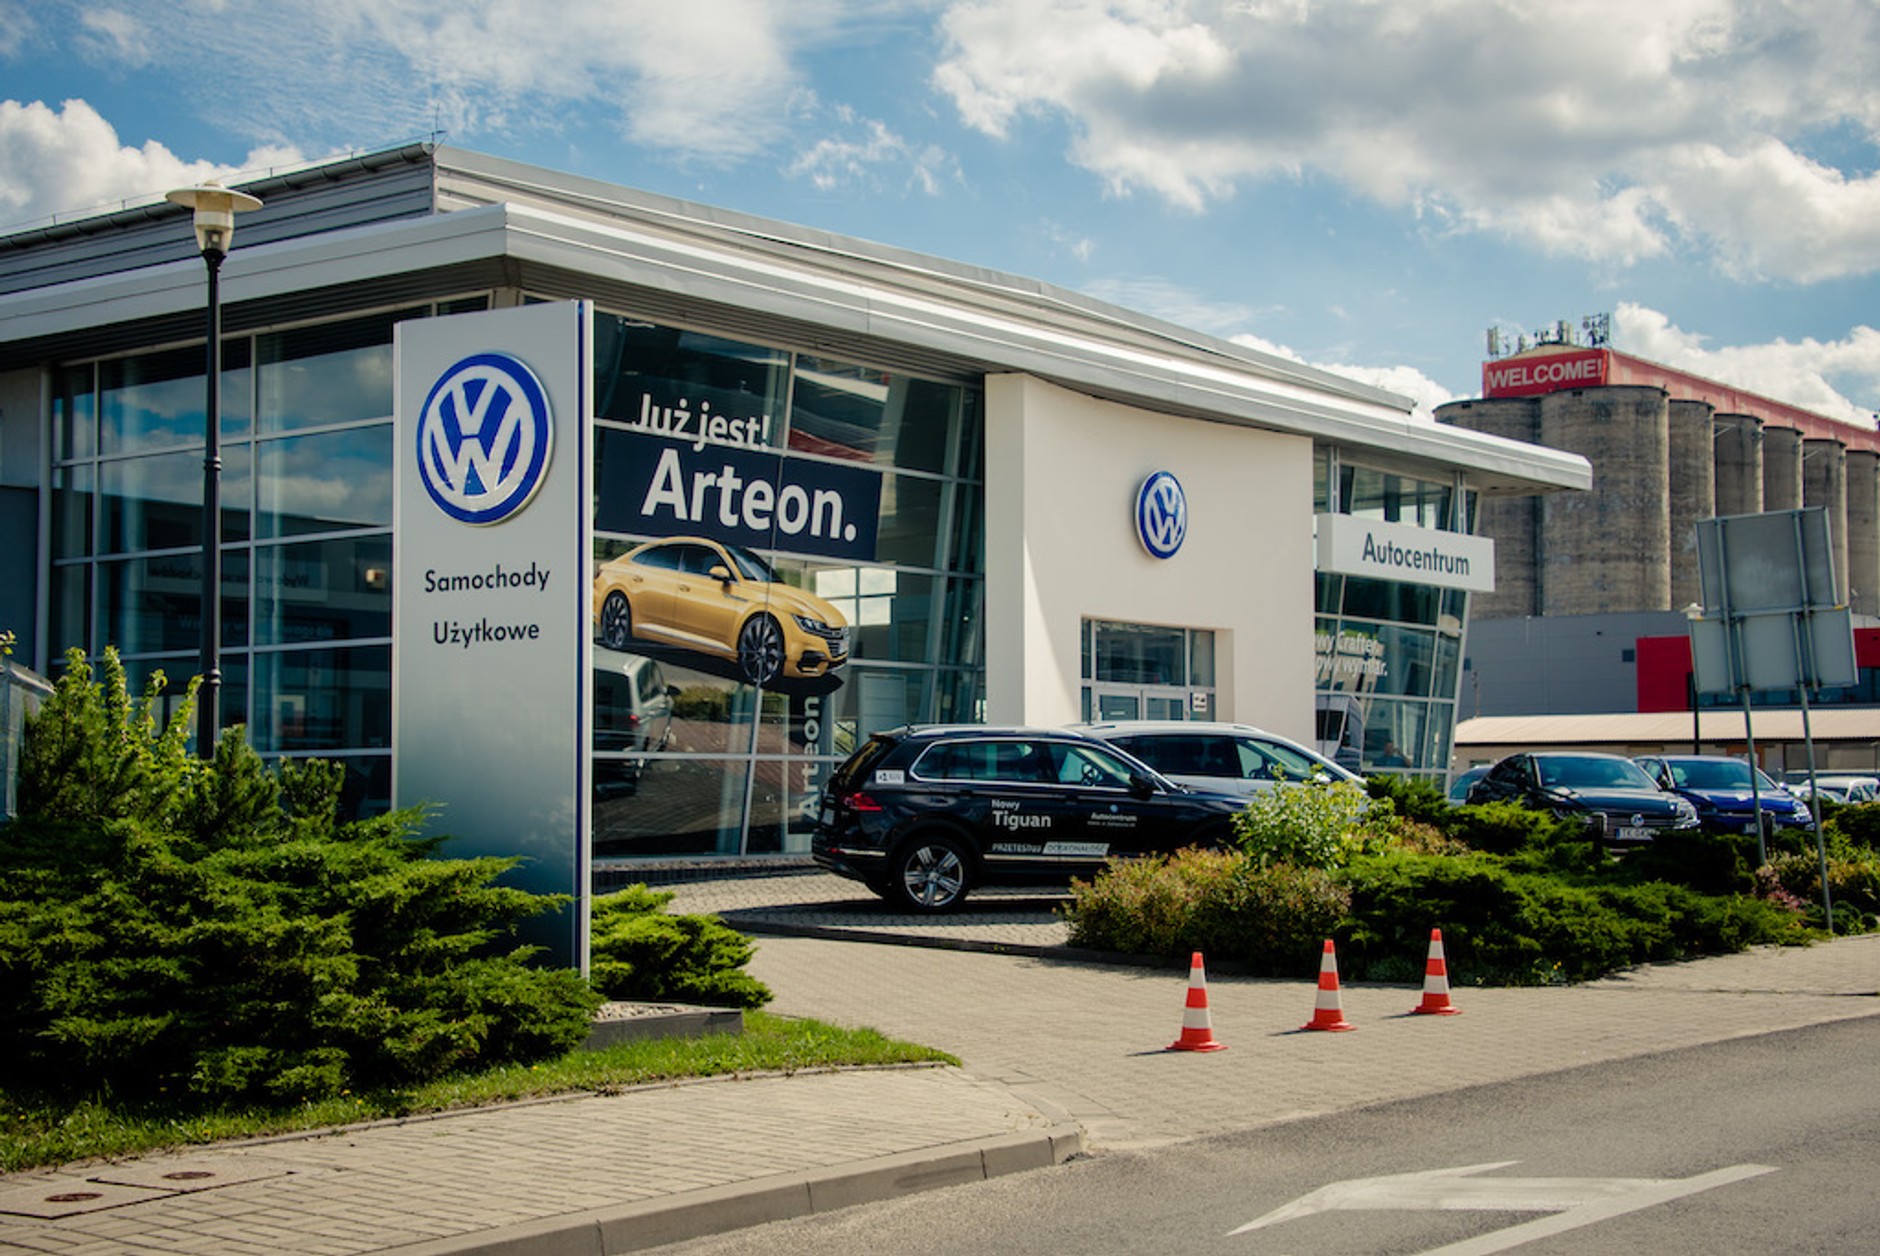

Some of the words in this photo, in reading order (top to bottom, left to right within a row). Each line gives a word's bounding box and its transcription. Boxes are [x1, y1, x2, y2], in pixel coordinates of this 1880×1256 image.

[1488, 358, 1603, 389] WELCOME!
[631, 393, 690, 439] Już
[693, 401, 770, 454] jest!
[640, 448, 857, 542] Arteon.
[1361, 532, 1470, 576] Autocentrum
[424, 562, 551, 594] Samochody
[433, 618, 540, 650] Użytkowe
[1315, 634, 1335, 654] wy
[800, 696, 820, 821] Arteon
[991, 799, 1020, 811] Nowy
[992, 810, 1052, 831] Tiguan
